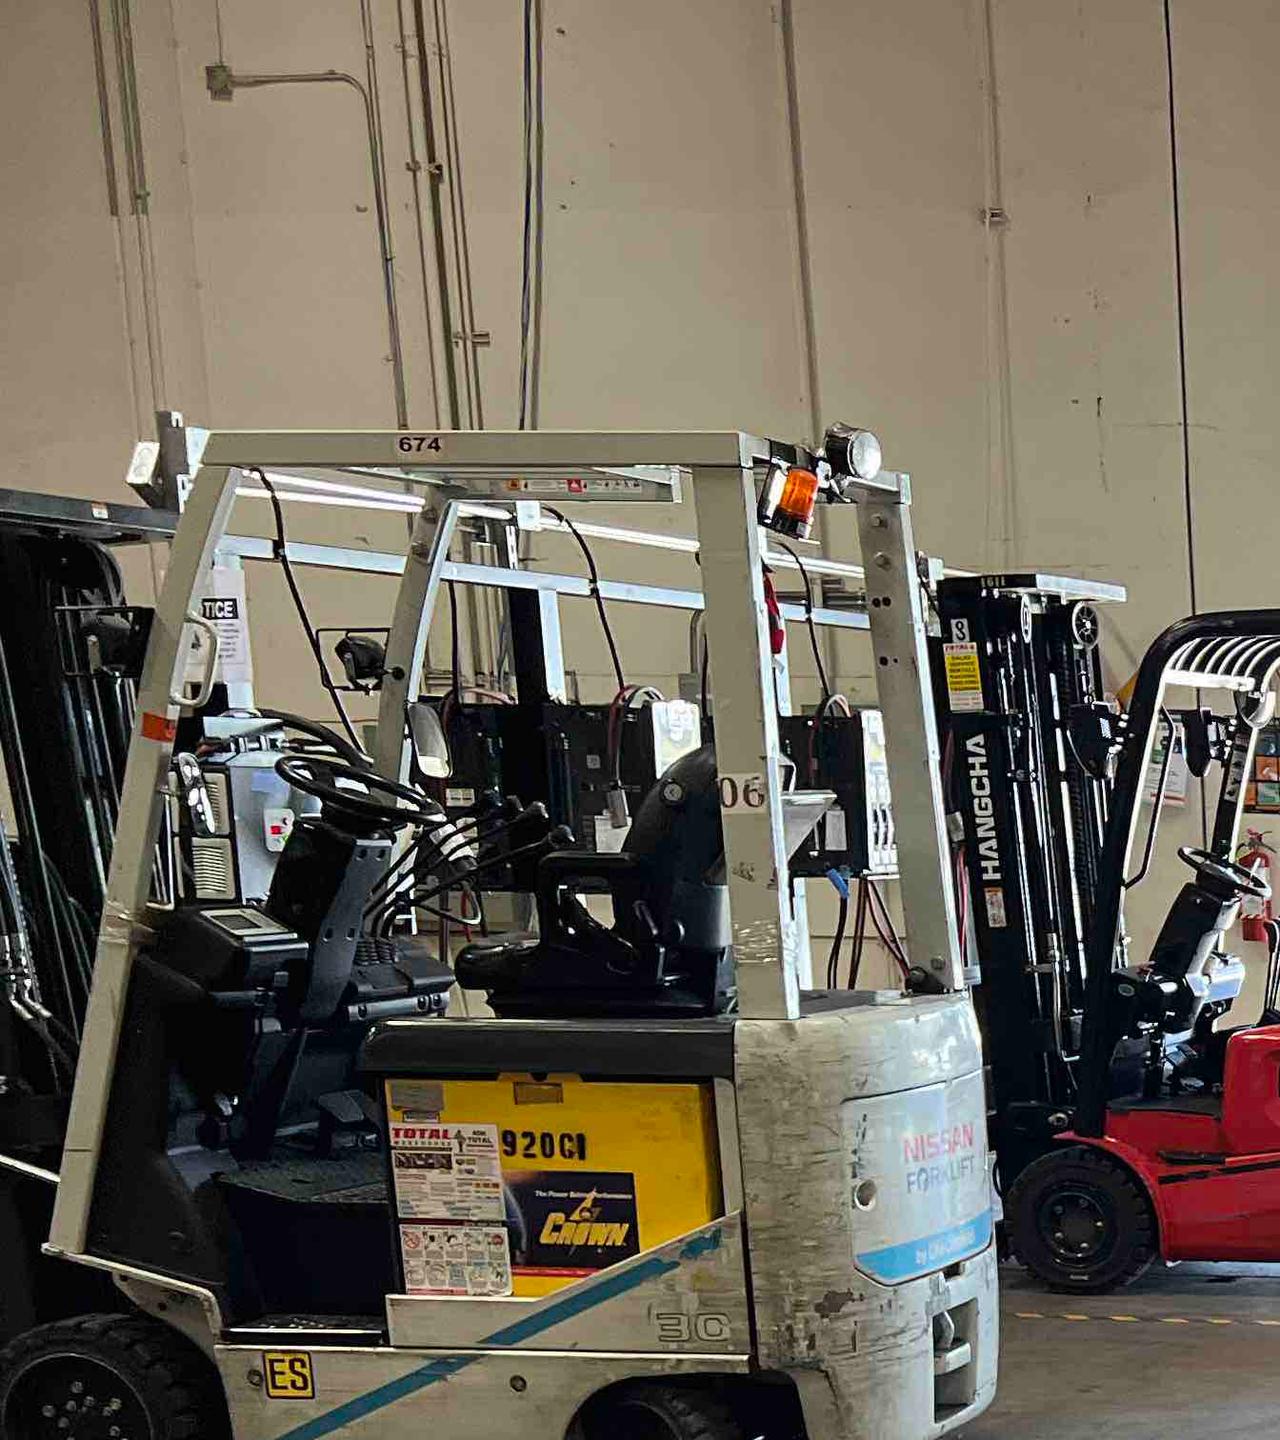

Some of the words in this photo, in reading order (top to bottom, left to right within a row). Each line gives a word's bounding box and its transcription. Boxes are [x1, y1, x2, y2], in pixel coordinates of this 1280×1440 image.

[398, 437, 441, 452] 674
[203, 601, 234, 618] TICE
[965, 733, 1001, 881] HANGCHA
[392, 1128, 449, 1140] TOTAL
[904, 1123, 973, 1163] NISSAN
[269, 1358, 309, 1390] ES
